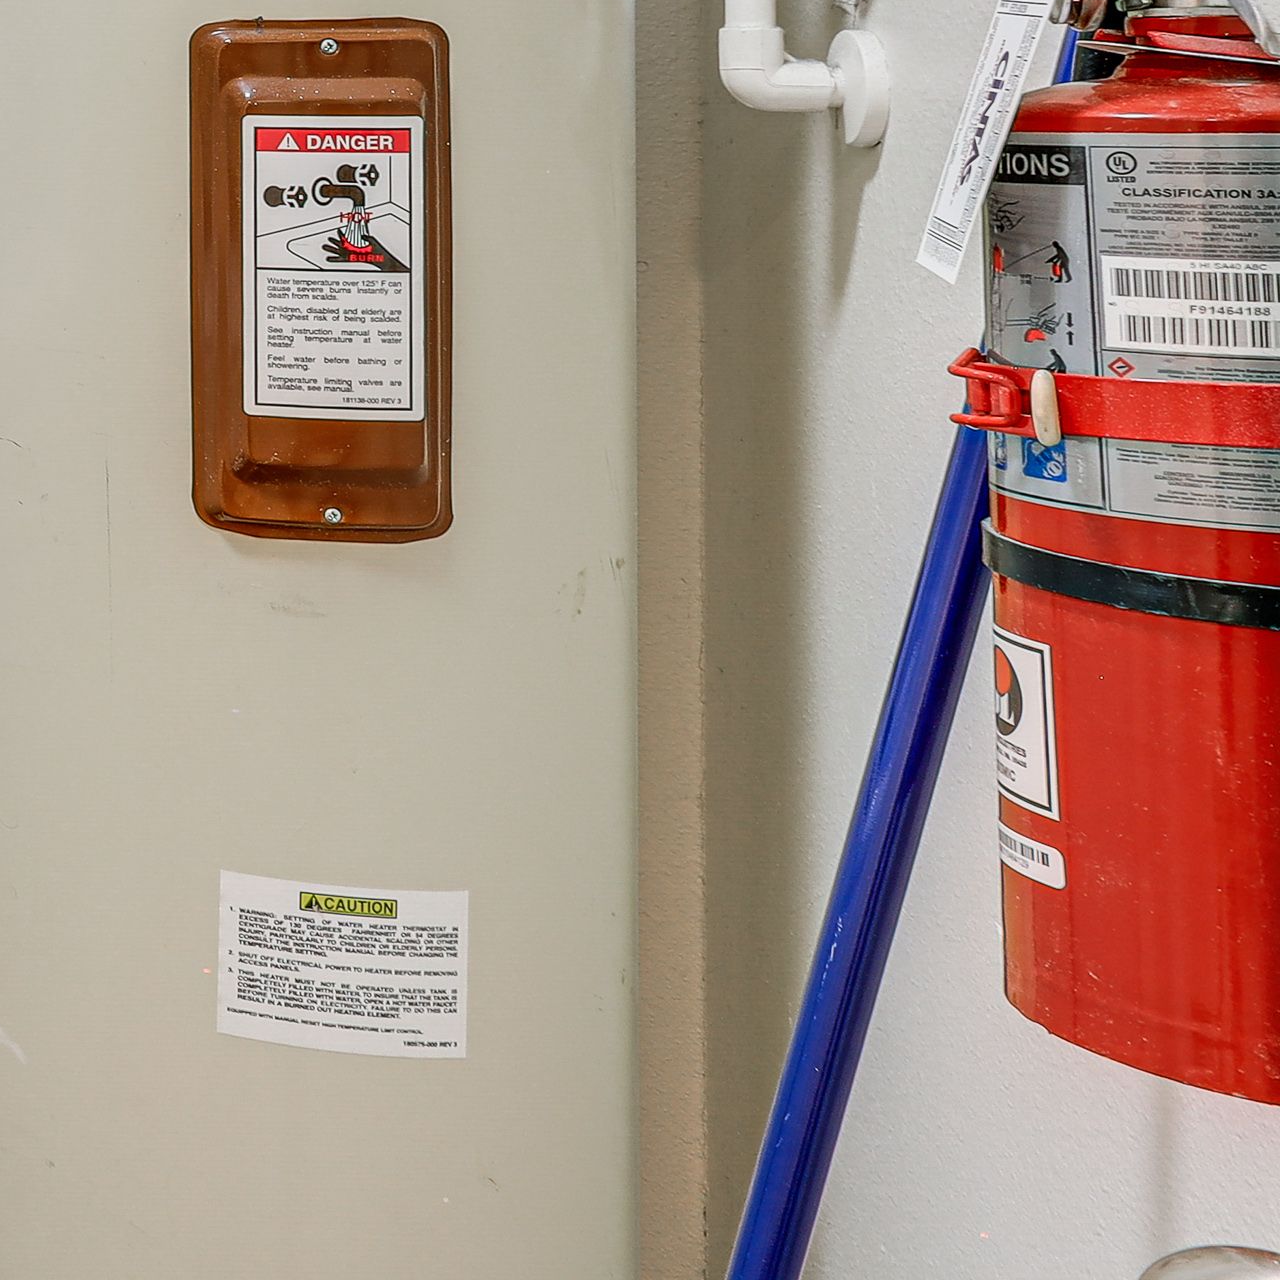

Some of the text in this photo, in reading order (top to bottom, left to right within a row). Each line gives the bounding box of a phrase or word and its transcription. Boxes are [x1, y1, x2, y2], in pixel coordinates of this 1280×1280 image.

[959, 50, 1010, 186] CINTAS
[306, 134, 394, 150] DANGER
[1122, 187, 1252, 199] CLASSIFICATION
[1155, 202, 1206, 210] ACCORDANCE
[340, 211, 373, 223] HOT
[349, 254, 384, 262] BURN
[1244, 263, 1268, 271] ABC
[266, 277, 290, 285] Water
[292, 279, 340, 288] temperature
[329, 286, 352, 294] burns
[356, 287, 389, 295] instantly
[291, 292, 309, 300] from
[311, 293, 338, 301] scalds.
[267, 305, 303, 314] Children,
[306, 307, 340, 315] disabled
[343, 307, 358, 315] and
[361, 308, 386, 318] elderly
[280, 313, 313, 322] highest
[344, 315, 366, 323] being
[370, 315, 402, 323] scalded.
[267, 326, 283, 334] See
[291, 327, 333, 335] instruction
[341, 329, 370, 337] manual
[267, 334, 294, 342] setting
[304, 335, 353, 343] temperature
[267, 361, 310, 371] showering.
[324, 356, 350, 364] before
[357, 357, 387, 366] bathing
[268, 375, 318, 385] Temperature
[324, 377, 353, 387] limiting
[267, 383, 305, 392] available,
[324, 897, 394, 916] CAUTION
[283, 914, 315, 924] SETTING
[338, 921, 363, 929] WATER
[369, 923, 397, 931] HEATER
[340, 940, 376, 949] CHILDREN
[238, 951, 258, 960] SHUT
[277, 957, 323, 969] ELECTRICAL
[325, 964, 351, 972] POWER
[364, 967, 392, 975] HEATER
[238, 968, 255, 977] THIS
[259, 972, 290, 982] HEATER
[294, 978, 315, 986] MUST
[355, 985, 395, 993] OPERATED
[237, 994, 266, 1005] RESULT
[284, 1002, 315, 1011] BURNED
[334, 1009, 365, 1017] HEATING
[367, 1011, 401, 1019] ELEMENT.
